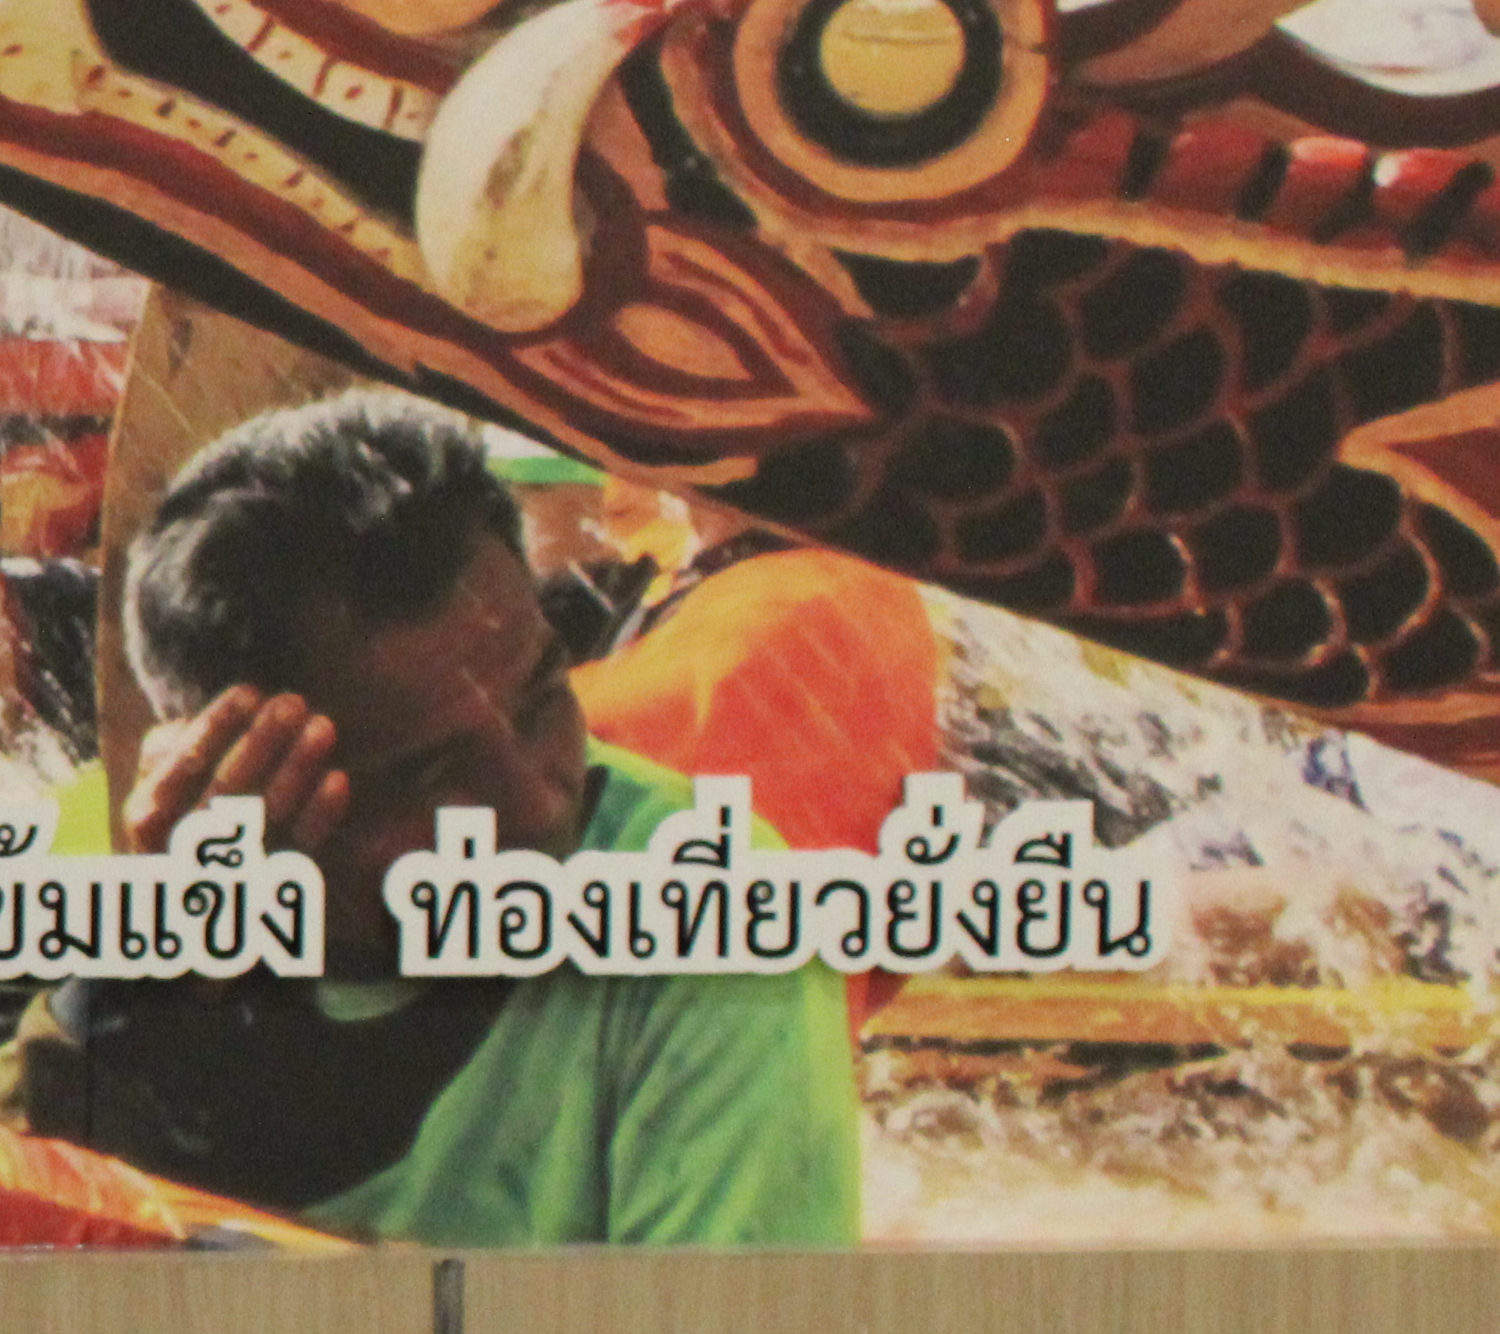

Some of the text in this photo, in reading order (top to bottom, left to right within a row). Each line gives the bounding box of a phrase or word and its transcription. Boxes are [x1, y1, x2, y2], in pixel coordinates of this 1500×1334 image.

[410, 800, 1153, 963] ท่องเที่ยวยั่งยืน
